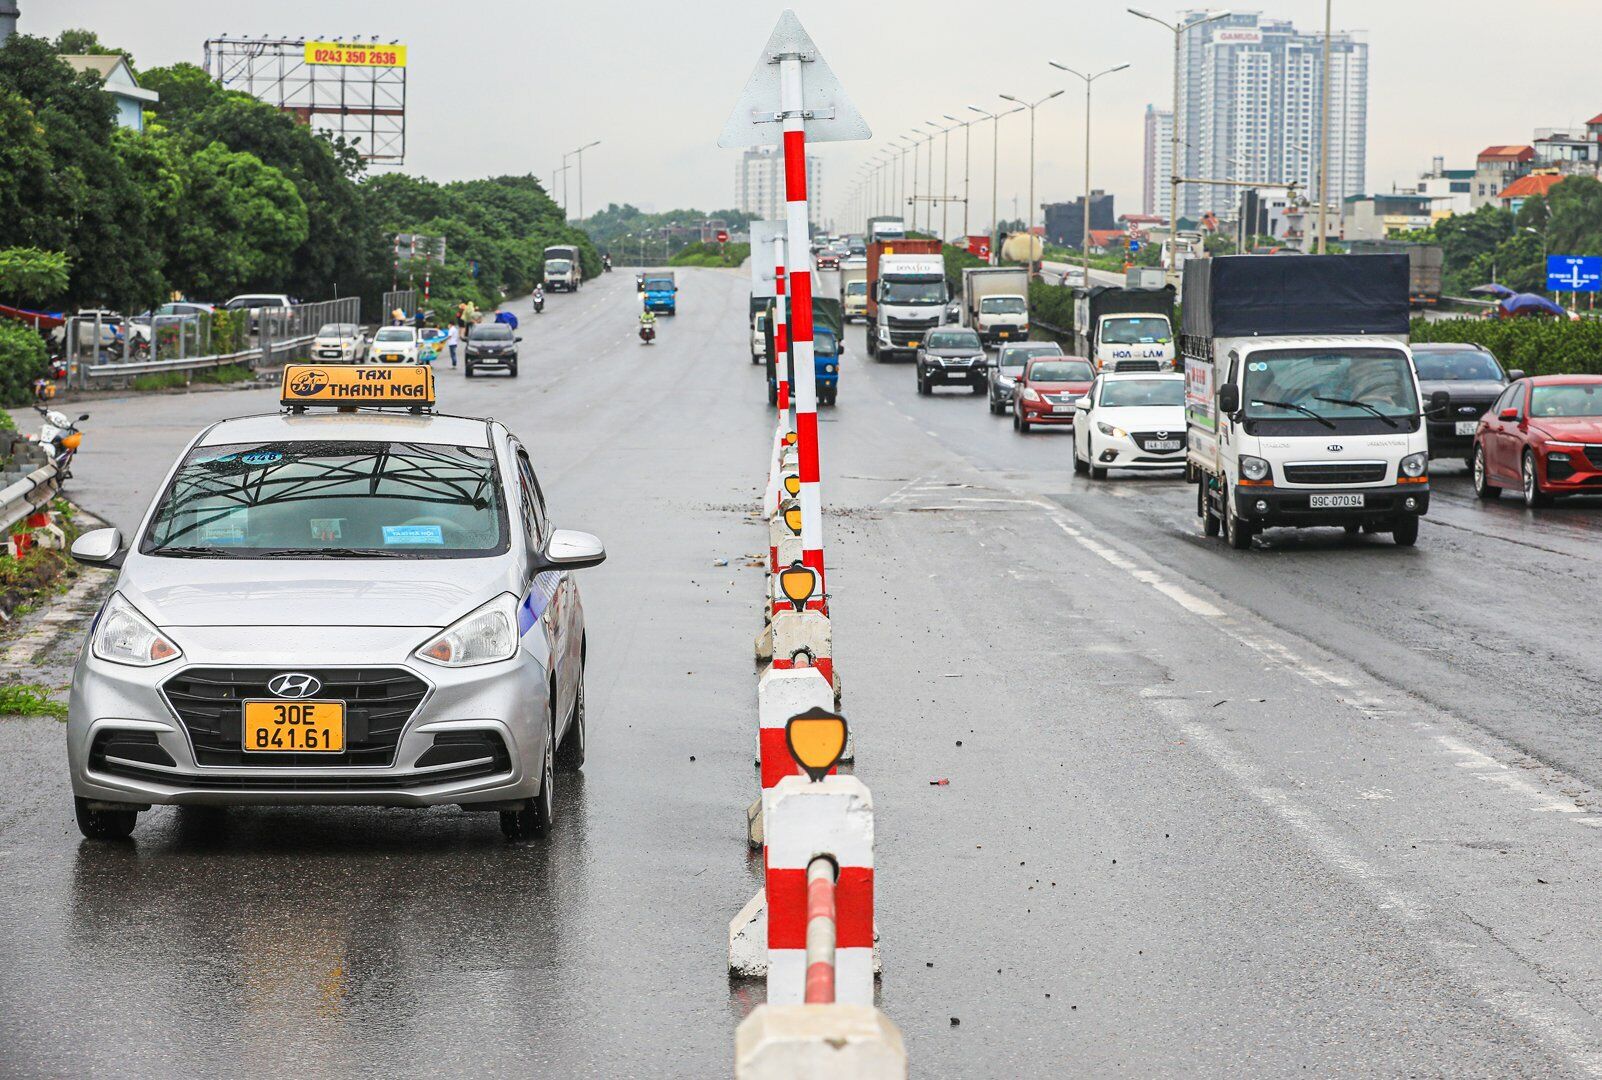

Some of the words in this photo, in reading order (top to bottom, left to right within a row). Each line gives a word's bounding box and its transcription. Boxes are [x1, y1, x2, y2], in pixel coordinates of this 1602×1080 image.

[315, 50, 342, 62] 0243
[345, 51, 366, 63] 350
[369, 52, 396, 65] 2636
[355, 369, 392, 380] TAXI
[328, 384, 384, 397] THANH
[391, 384, 424, 398] NGA
[247, 452, 277, 462] 448
[273, 705, 316, 725] 30E
[255, 727, 330, 749] 841.61
